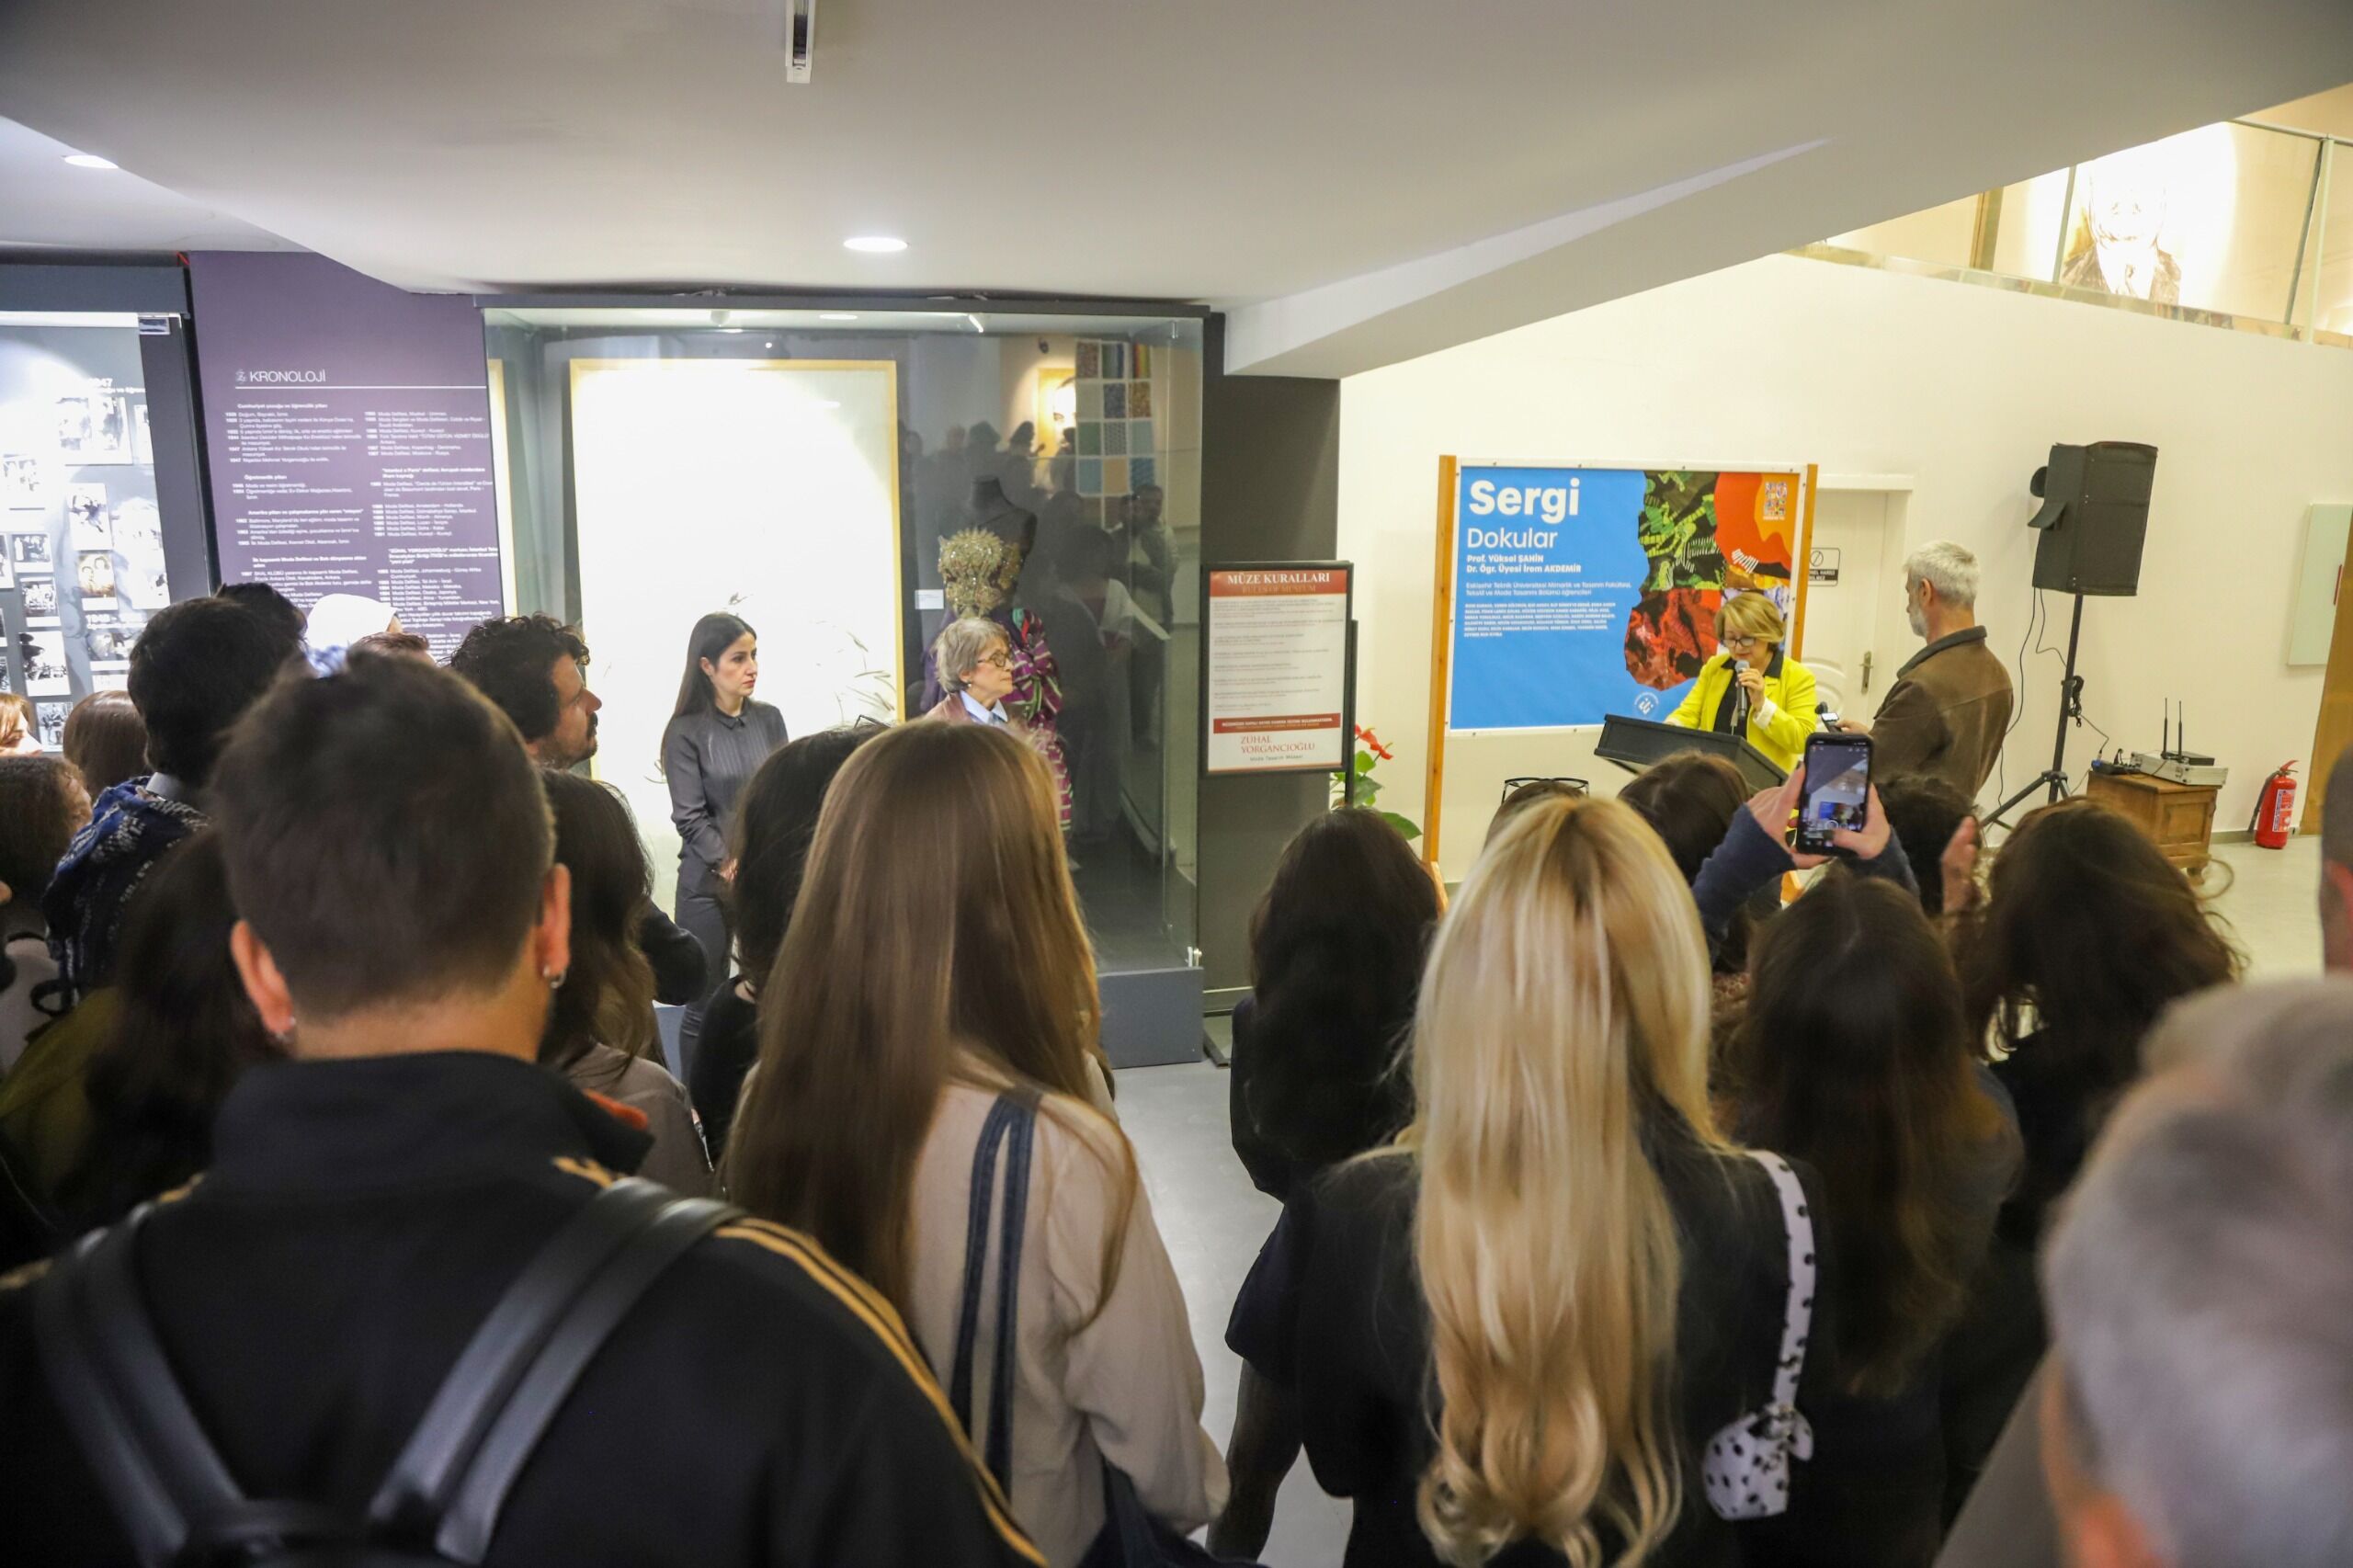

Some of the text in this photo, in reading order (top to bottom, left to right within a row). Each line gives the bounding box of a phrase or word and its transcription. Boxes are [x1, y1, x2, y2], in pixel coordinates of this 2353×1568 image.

[250, 369, 326, 382] KRONOLOJİ
[1469, 477, 1580, 524] Sergi
[1467, 528, 1557, 548] Dokular
[1467, 553, 1544, 563] Prof. Yüksel ŞAHİN
[1228, 572, 1330, 585] MÜZE KURALLARI
[1241, 735, 1271, 744] ZÜHAL
[1241, 742, 1315, 753] YORGANCIOĞLU
